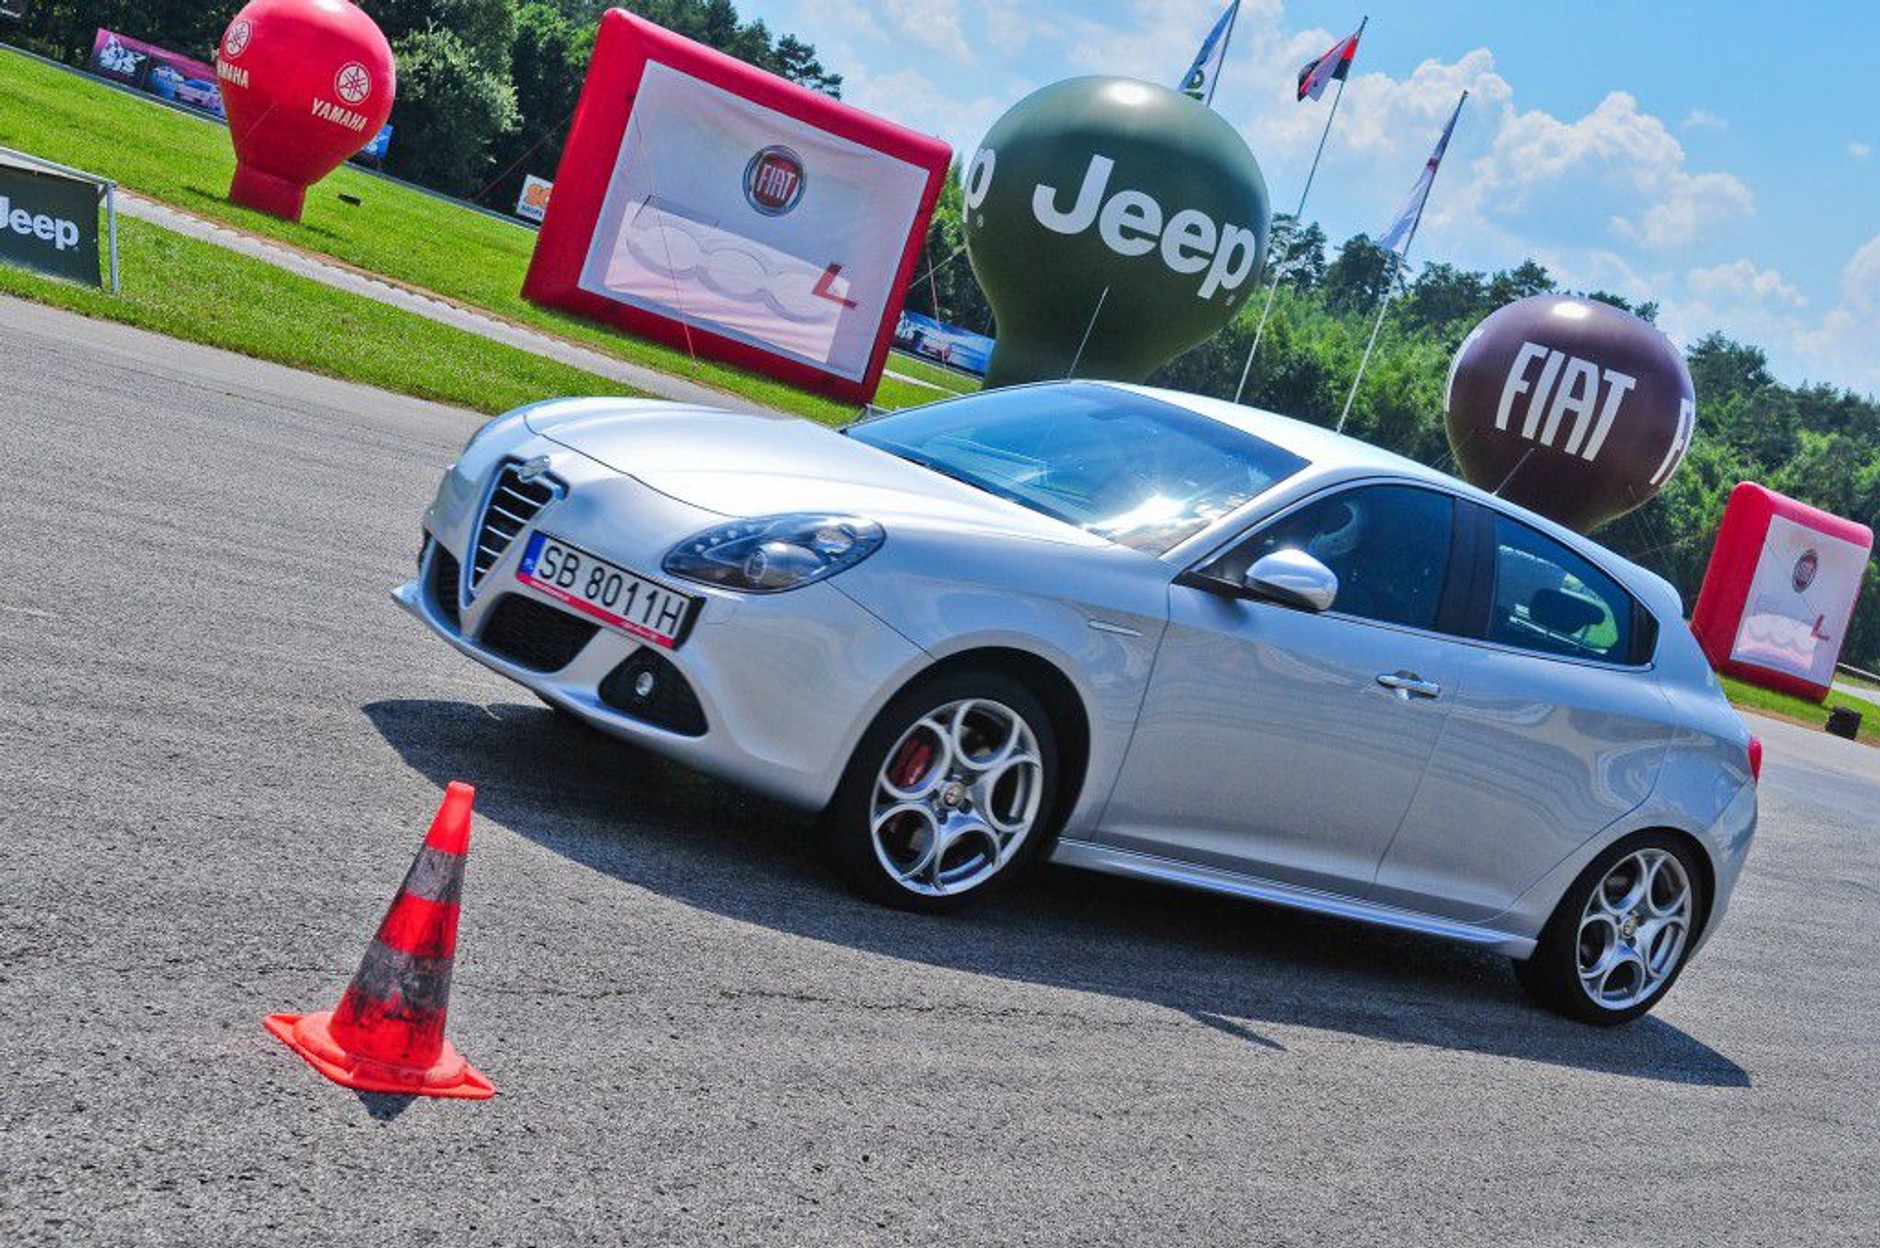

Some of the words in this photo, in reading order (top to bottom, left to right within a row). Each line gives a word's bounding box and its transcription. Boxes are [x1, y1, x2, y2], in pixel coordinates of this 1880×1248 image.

[311, 97, 368, 132] YAMAHA
[757, 164, 796, 200] FIAT
[1032, 154, 1255, 300] Jeep
[1495, 341, 1637, 462] FIAT
[538, 544, 581, 589] SB
[584, 565, 685, 635] 8011H
